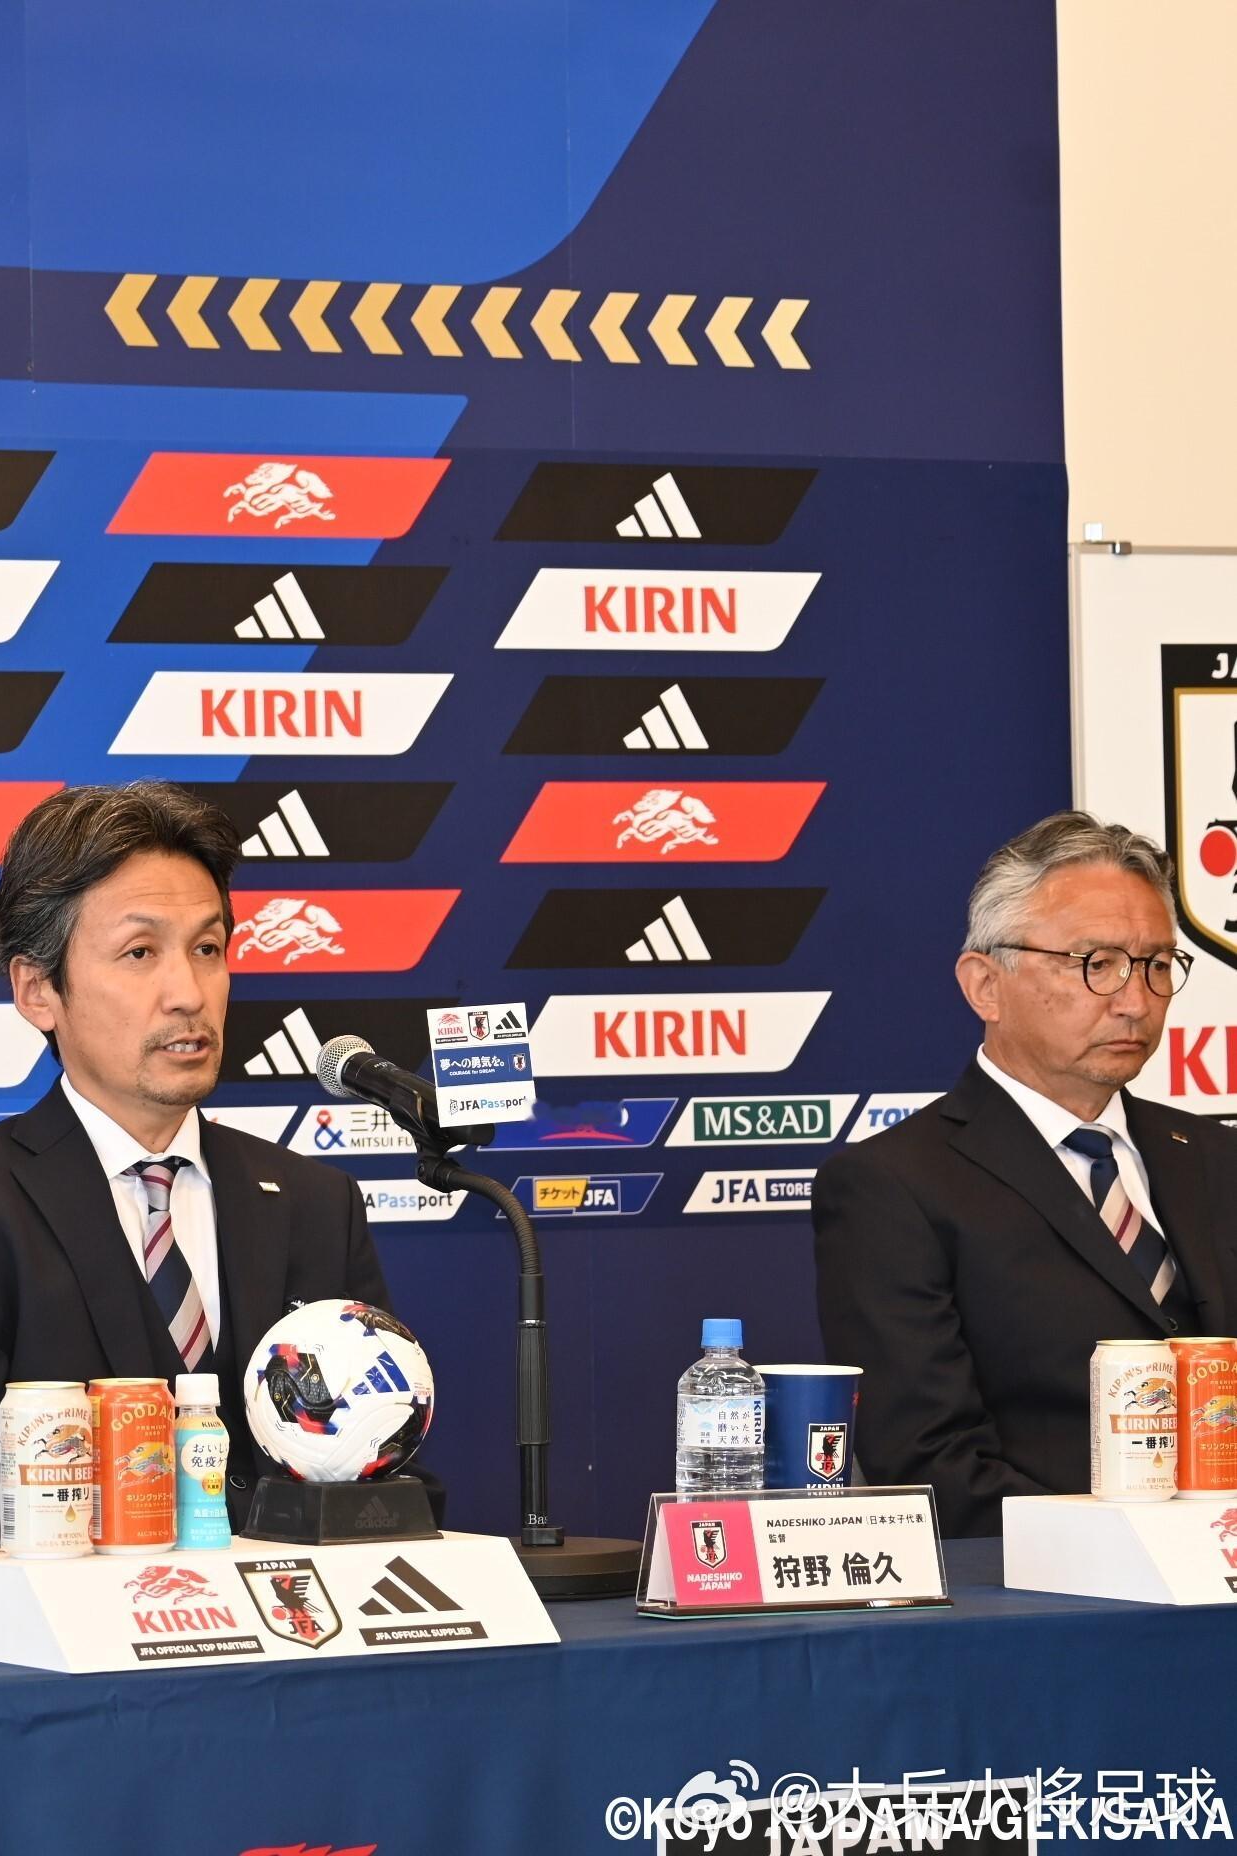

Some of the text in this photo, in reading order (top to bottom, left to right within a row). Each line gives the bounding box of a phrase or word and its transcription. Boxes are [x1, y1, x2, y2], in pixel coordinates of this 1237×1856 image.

[584, 586, 738, 634] KIRIN
[200, 689, 362, 738] KIRIN
[437, 1027, 463, 1036] KIRIN
[593, 1009, 747, 1059] KIRIN
[439, 1055, 504, 1071] 夢への勇気を。
[703, 1104, 824, 1137] MS&AD
[350, 1136, 394, 1148] MITSUI
[540, 1186, 580, 1200] チケット
[583, 1189, 615, 1206] JFA
[711, 1179, 812, 1204] JFA STORE
[1186, 1360, 1229, 1386] GOOD
[111, 1403, 157, 1431] GOOD
[753, 1400, 762, 1445] KIRIN
[1117, 1417, 1160, 1431] KIRIN
[193, 1442, 227, 1454] おいし
[1131, 1436, 1175, 1449] 一番搾り
[819, 1461, 836, 1471] JFA
[26, 1467, 73, 1482] KIRIN
[42, 1488, 90, 1501] 一番搾り
[766, 1517, 826, 1528] NADESHIKO
[828, 1516, 863, 1526] JAPAN
[768, 1533, 786, 1543] 監督
[256, 1561, 297, 1571] JAPAN
[773, 1552, 902, 1589] 狩野 倫久
[687, 1572, 743, 1583] NADESHIKO
[699, 1581, 732, 1591] JAPAN
[131, 1605, 238, 1634] KIRIN
[288, 1619, 326, 1635] JFA
[375, 1627, 474, 1641] JFA OFFICIAL SUPPLIER
[140, 1640, 259, 1656] JFA OFFICIAL TOP PARTNER
